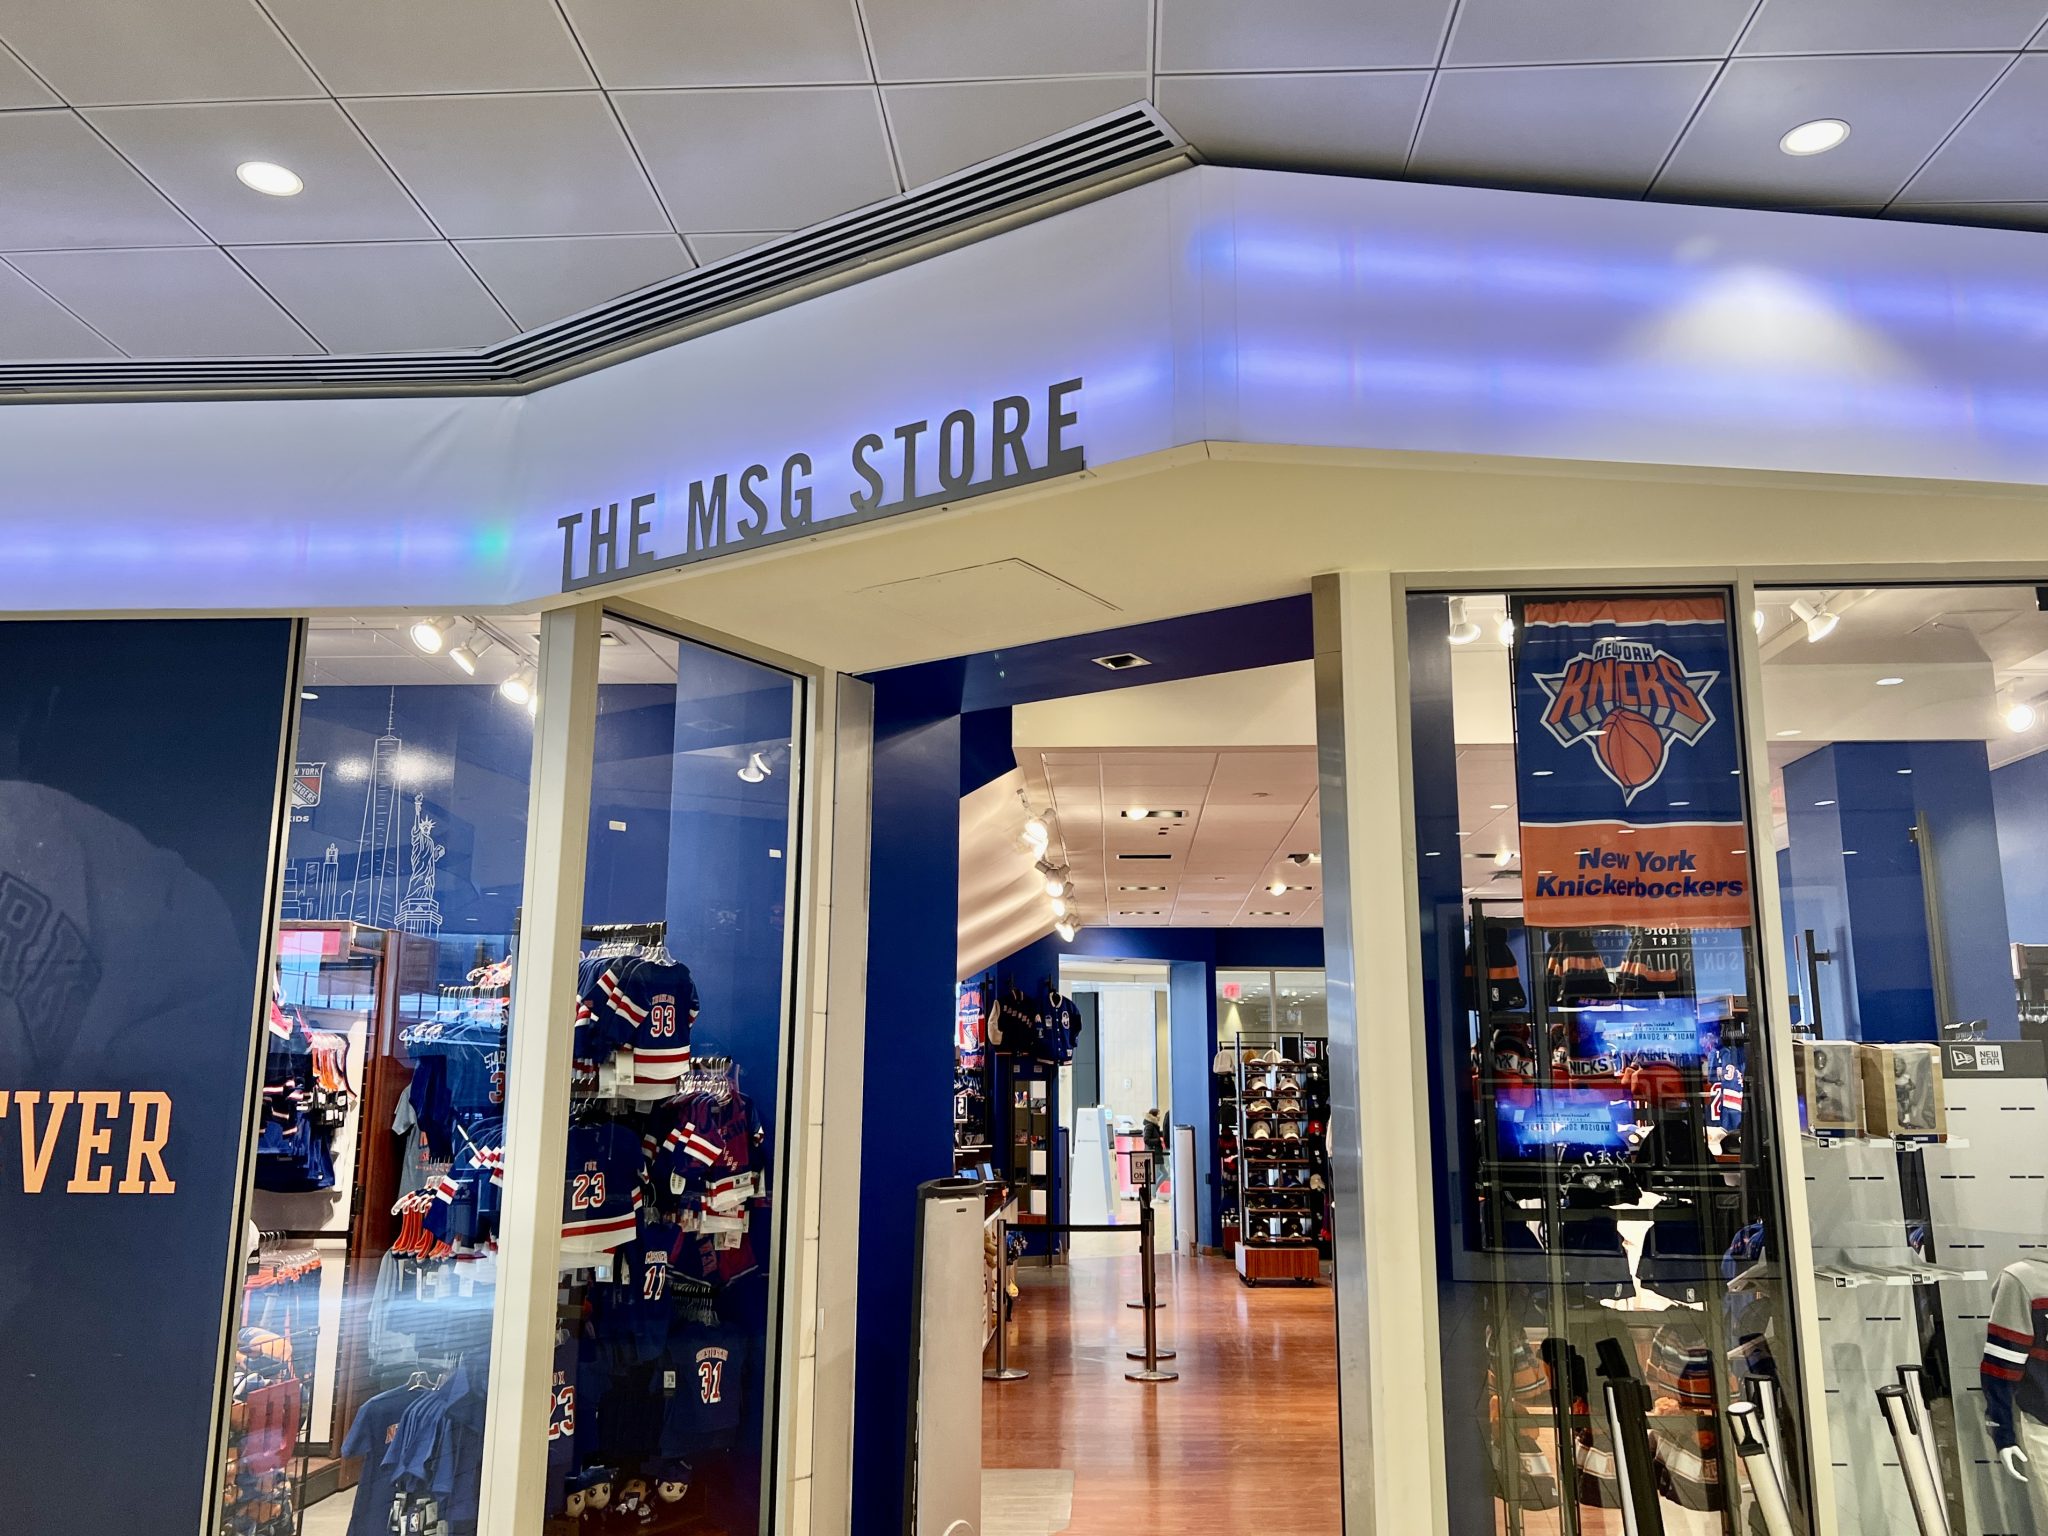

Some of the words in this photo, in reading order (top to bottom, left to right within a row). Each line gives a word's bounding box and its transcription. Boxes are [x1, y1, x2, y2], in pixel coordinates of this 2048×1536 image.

[557, 493, 657, 588] THE
[687, 452, 813, 555] MSG
[849, 377, 1084, 512] STORE
[1548, 655, 1709, 727] KNCKS
[292, 781, 317, 803] ANGERS
[1578, 847, 1630, 870] New
[1635, 849, 1697, 873] York
[1536, 873, 1744, 899] Knickerbockers
[650, 1005, 676, 1038] 93
[483, 1050, 506, 1074] STAR
[1569, 1057, 1609, 1077] NICKS
[1979, 1050, 1999, 1058] NEW
[1980, 1058, 2000, 1066] ERA
[0, 1090, 176, 1195] VER
[571, 1172, 606, 1211] 23
[643, 1265, 666, 1301] 11
[552, 1370, 566, 1386] OX
[698, 1361, 723, 1404] 31
